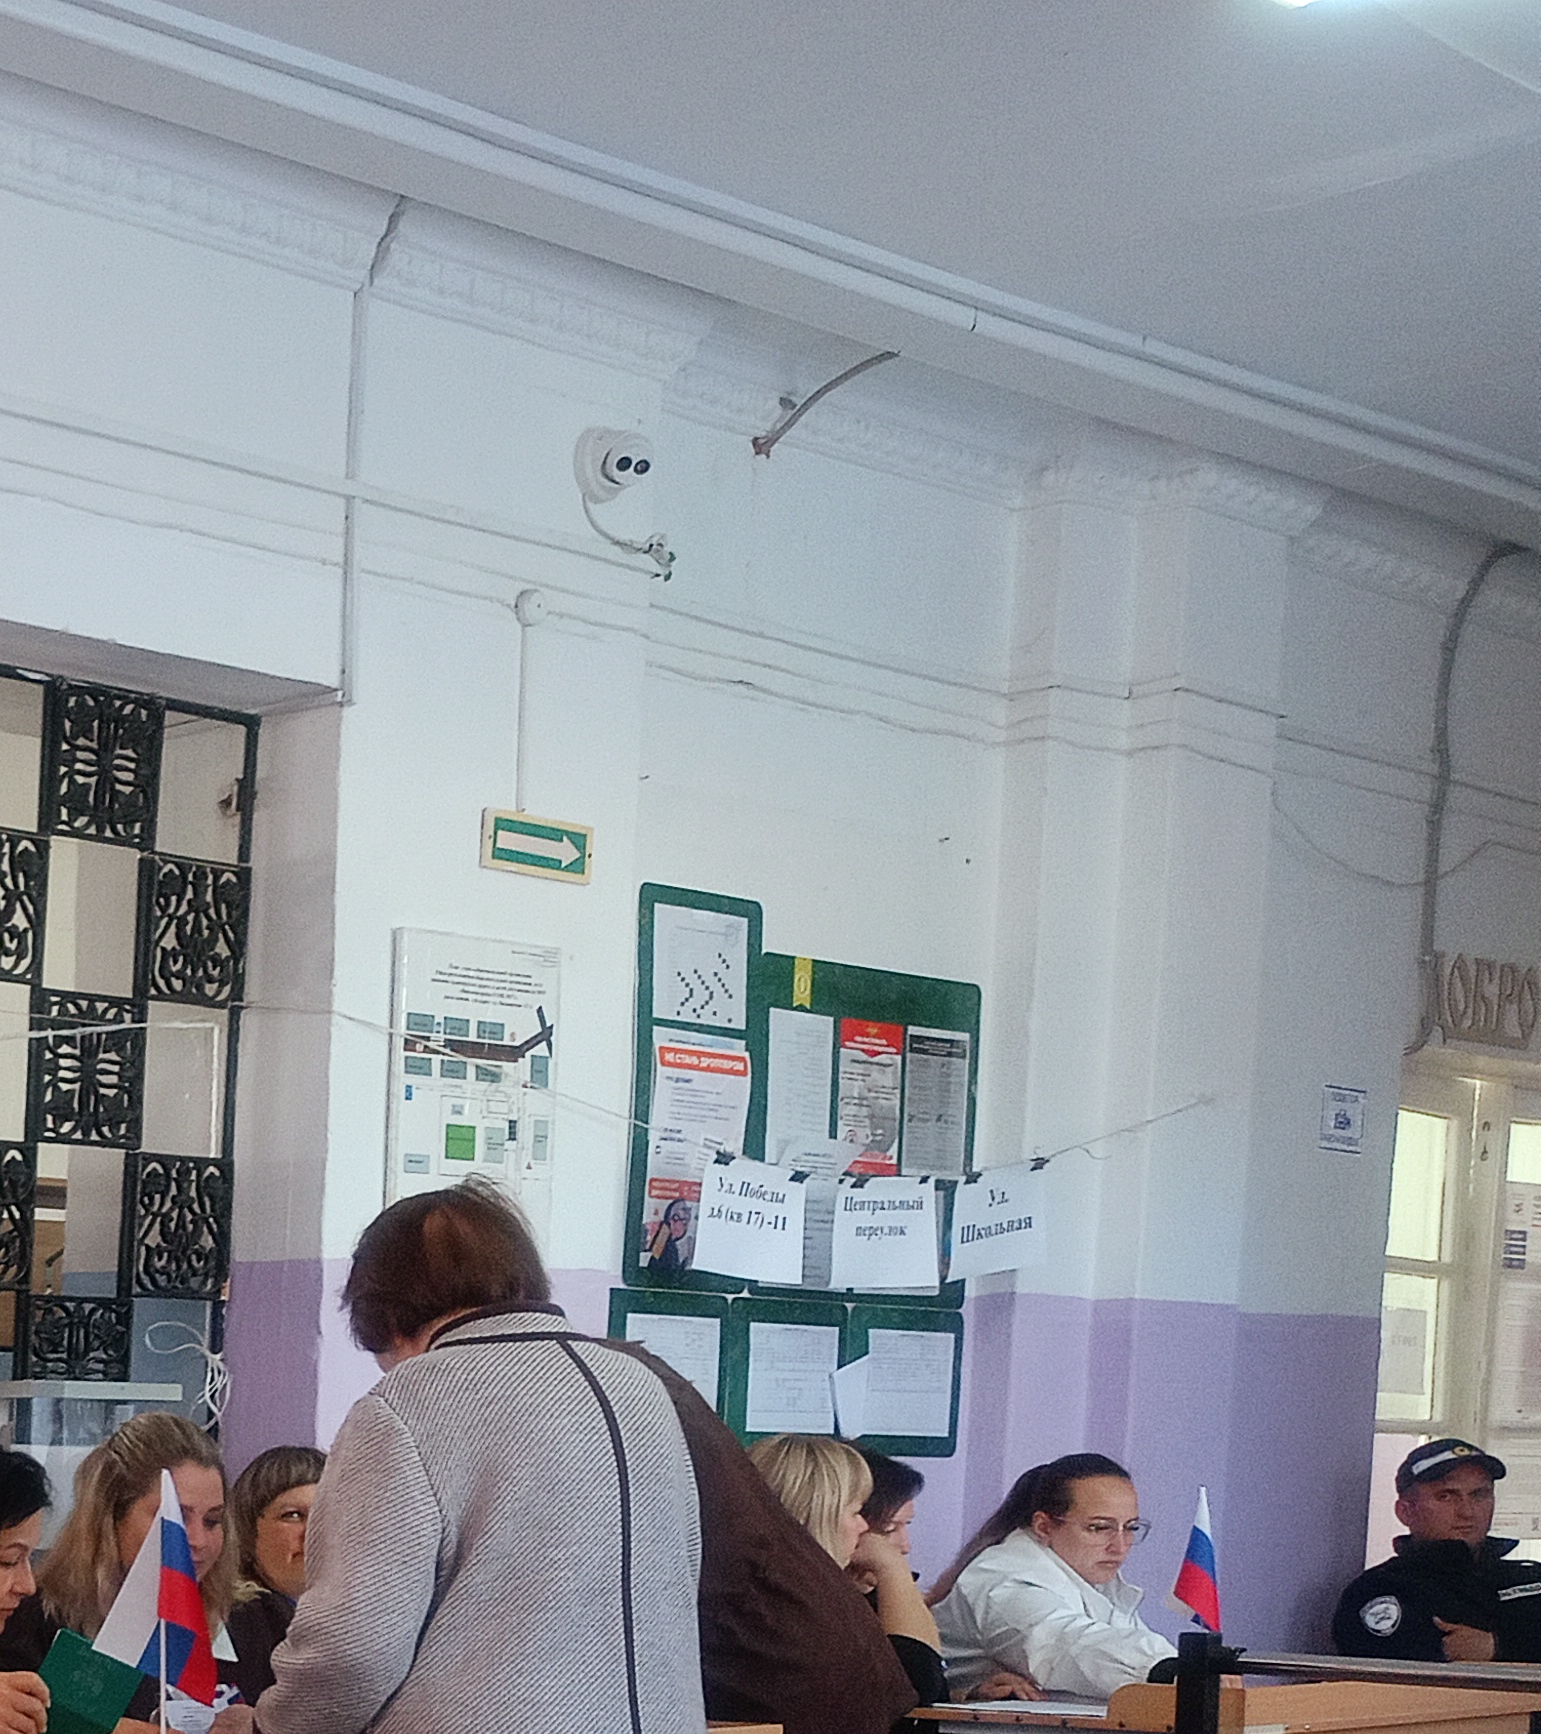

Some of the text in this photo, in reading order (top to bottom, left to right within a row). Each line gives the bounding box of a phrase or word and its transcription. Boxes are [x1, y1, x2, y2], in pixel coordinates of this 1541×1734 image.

[717, 1176, 736, 1195] Ул.
[738, 1181, 786, 1204] Победы
[843, 1195, 924, 1216] Центральный
[854, 1225, 908, 1241] переулок
[960, 1215, 1033, 1245] Школьная
